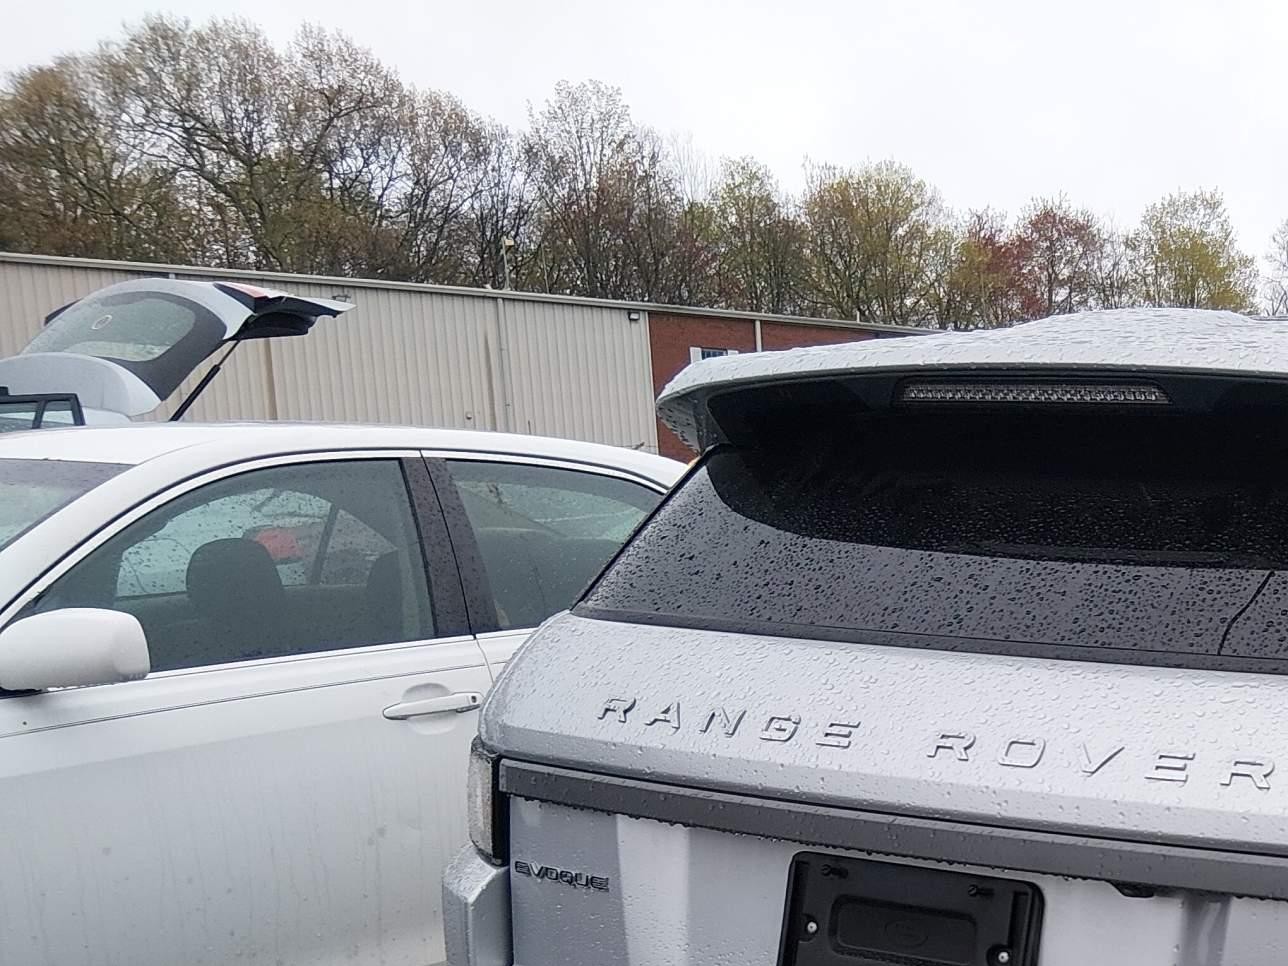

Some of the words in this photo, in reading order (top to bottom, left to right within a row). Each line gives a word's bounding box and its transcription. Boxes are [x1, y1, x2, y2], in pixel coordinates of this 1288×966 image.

[597, 698, 861, 749] RANGE
[926, 731, 1275, 789] ROVER
[514, 860, 609, 892] EVOQUE
